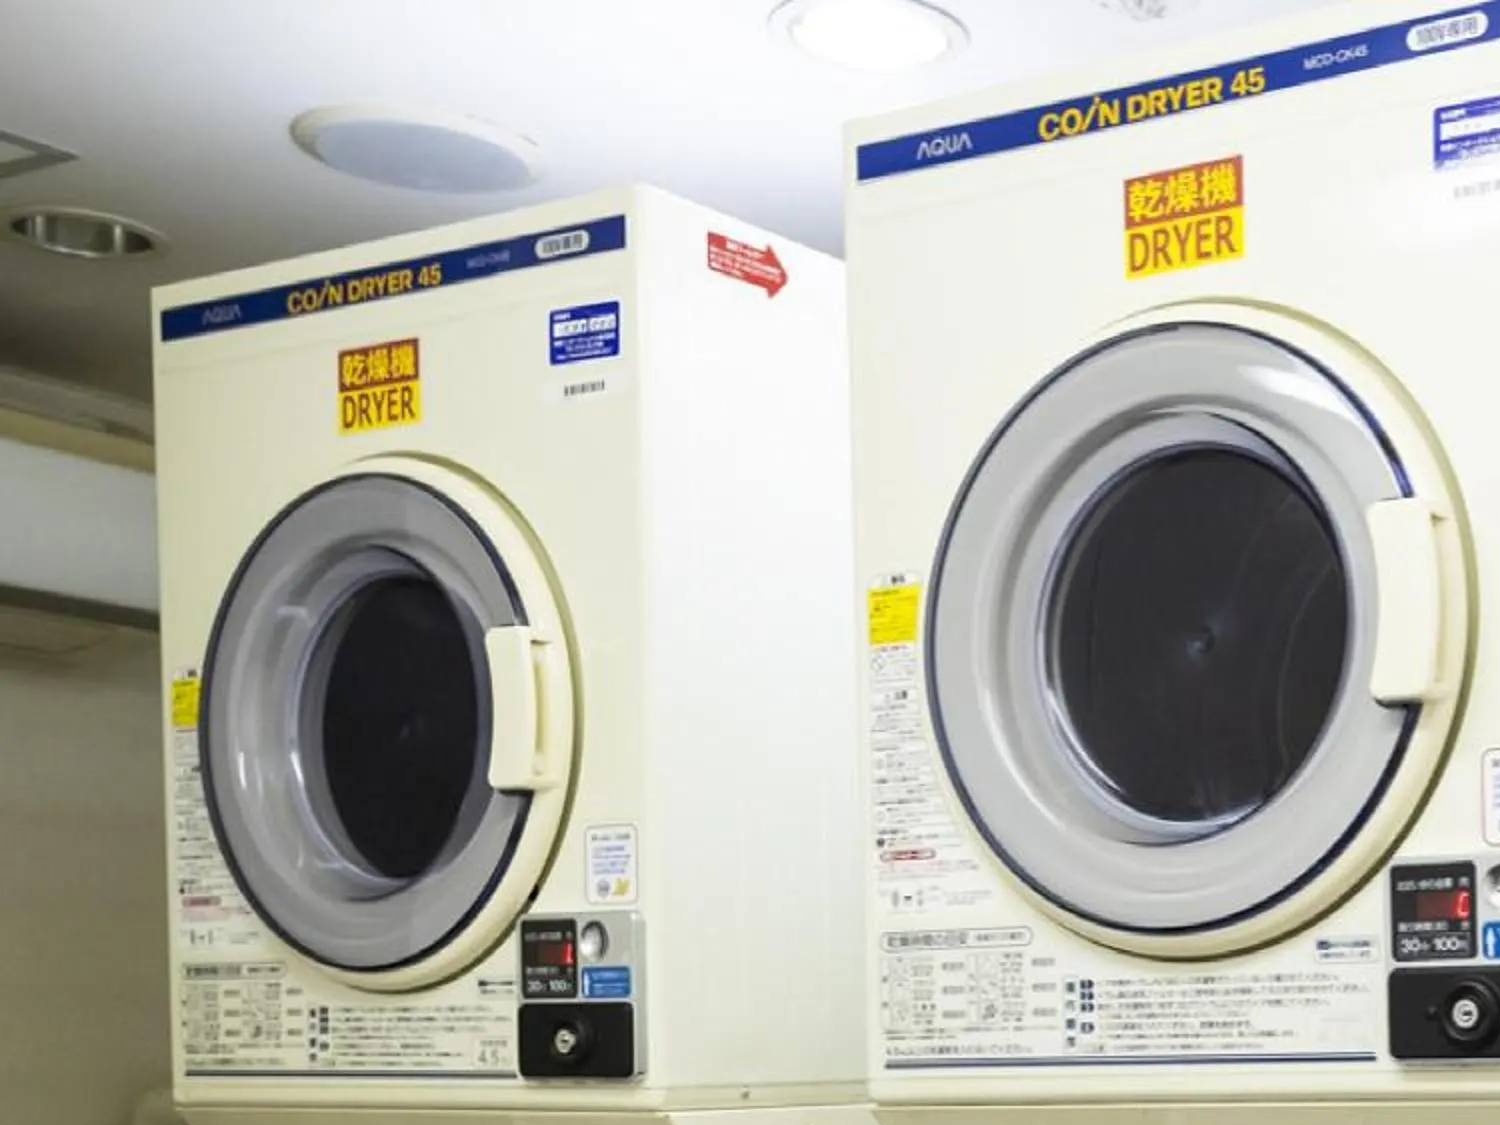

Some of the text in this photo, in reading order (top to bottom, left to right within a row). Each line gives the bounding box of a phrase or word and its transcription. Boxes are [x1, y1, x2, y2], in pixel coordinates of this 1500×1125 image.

[1127, 76, 1224, 121] DRYER
[1231, 67, 1266, 97] 45
[916, 133, 973, 160] AQUA
[1127, 164, 1237, 223] 乾燥機
[1128, 214, 1238, 273] DRYER
[349, 268, 412, 301] DRYER
[418, 263, 442, 286] 45
[342, 385, 416, 429] DRYER
